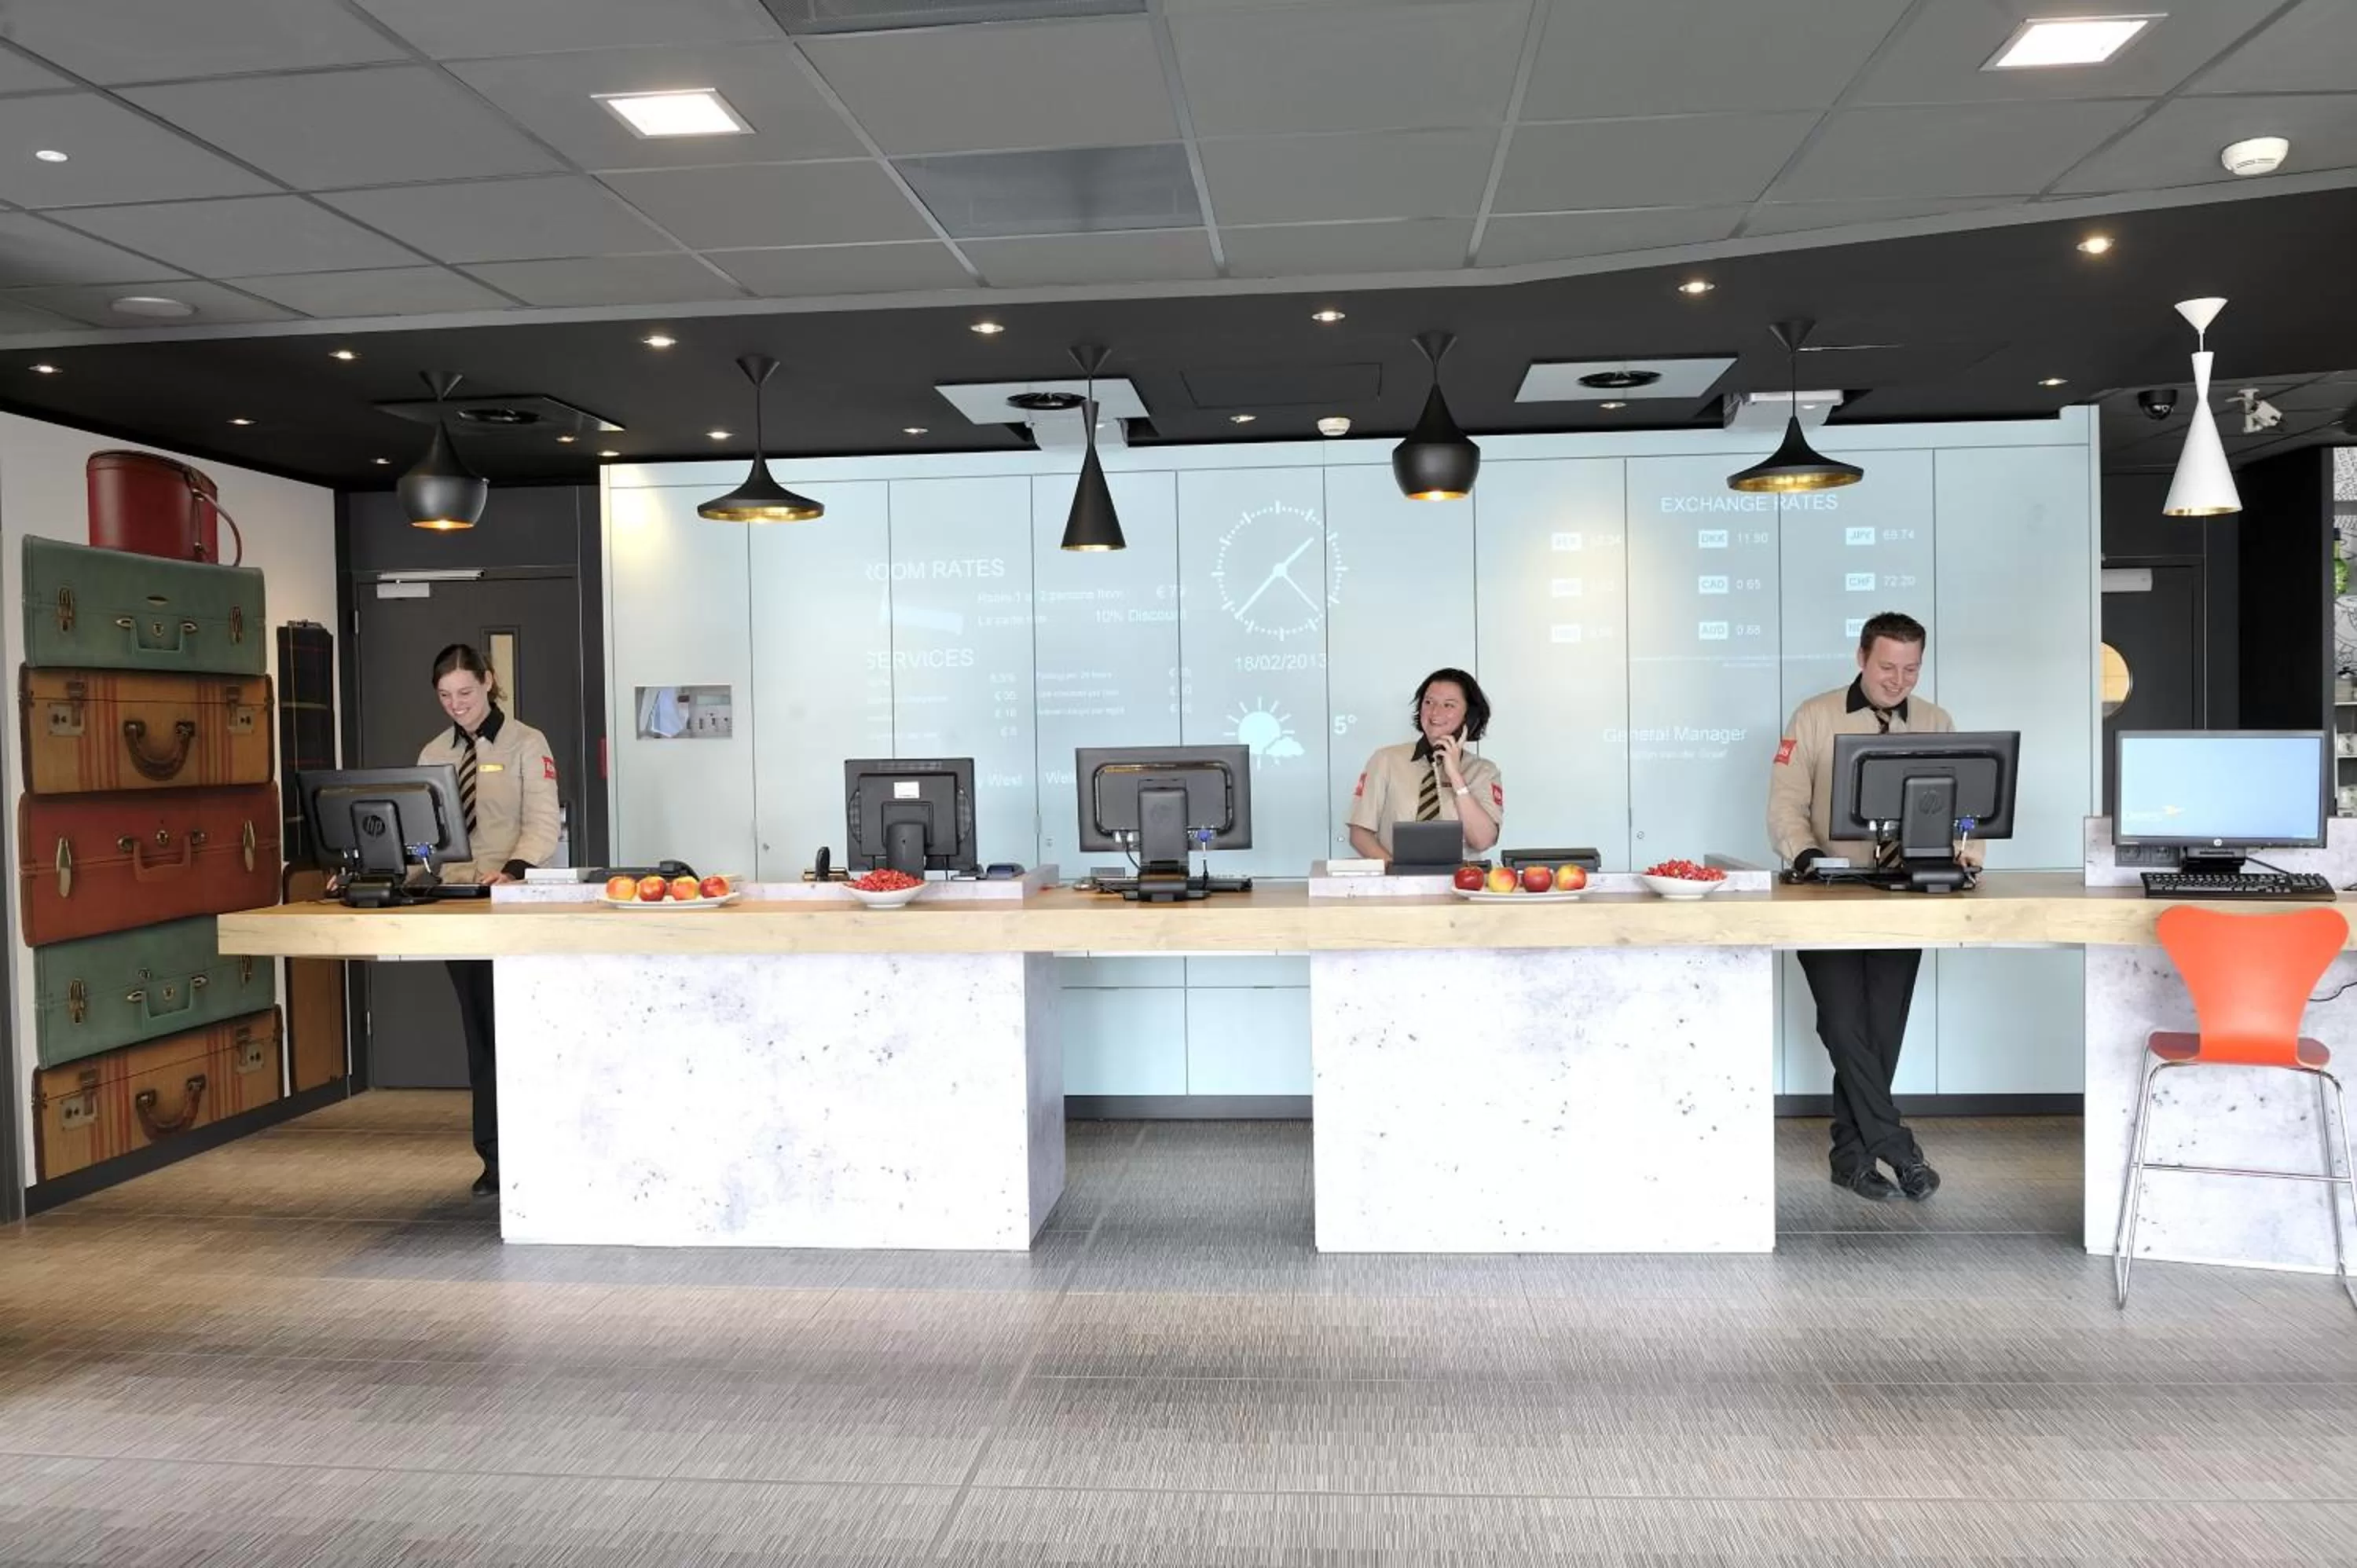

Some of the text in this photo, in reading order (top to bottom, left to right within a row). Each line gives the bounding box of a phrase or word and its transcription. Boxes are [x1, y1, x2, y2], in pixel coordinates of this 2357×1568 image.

[1660, 494, 1838, 513] EXCHANGE RATES
[932, 558, 1006, 579] RATES
[1701, 579, 1725, 589] CAD
[1849, 576, 1873, 586] CHF
[867, 648, 975, 670] SERVICES
[1333, 713, 1358, 736] 5°
[1603, 725, 1748, 745] General Manager
